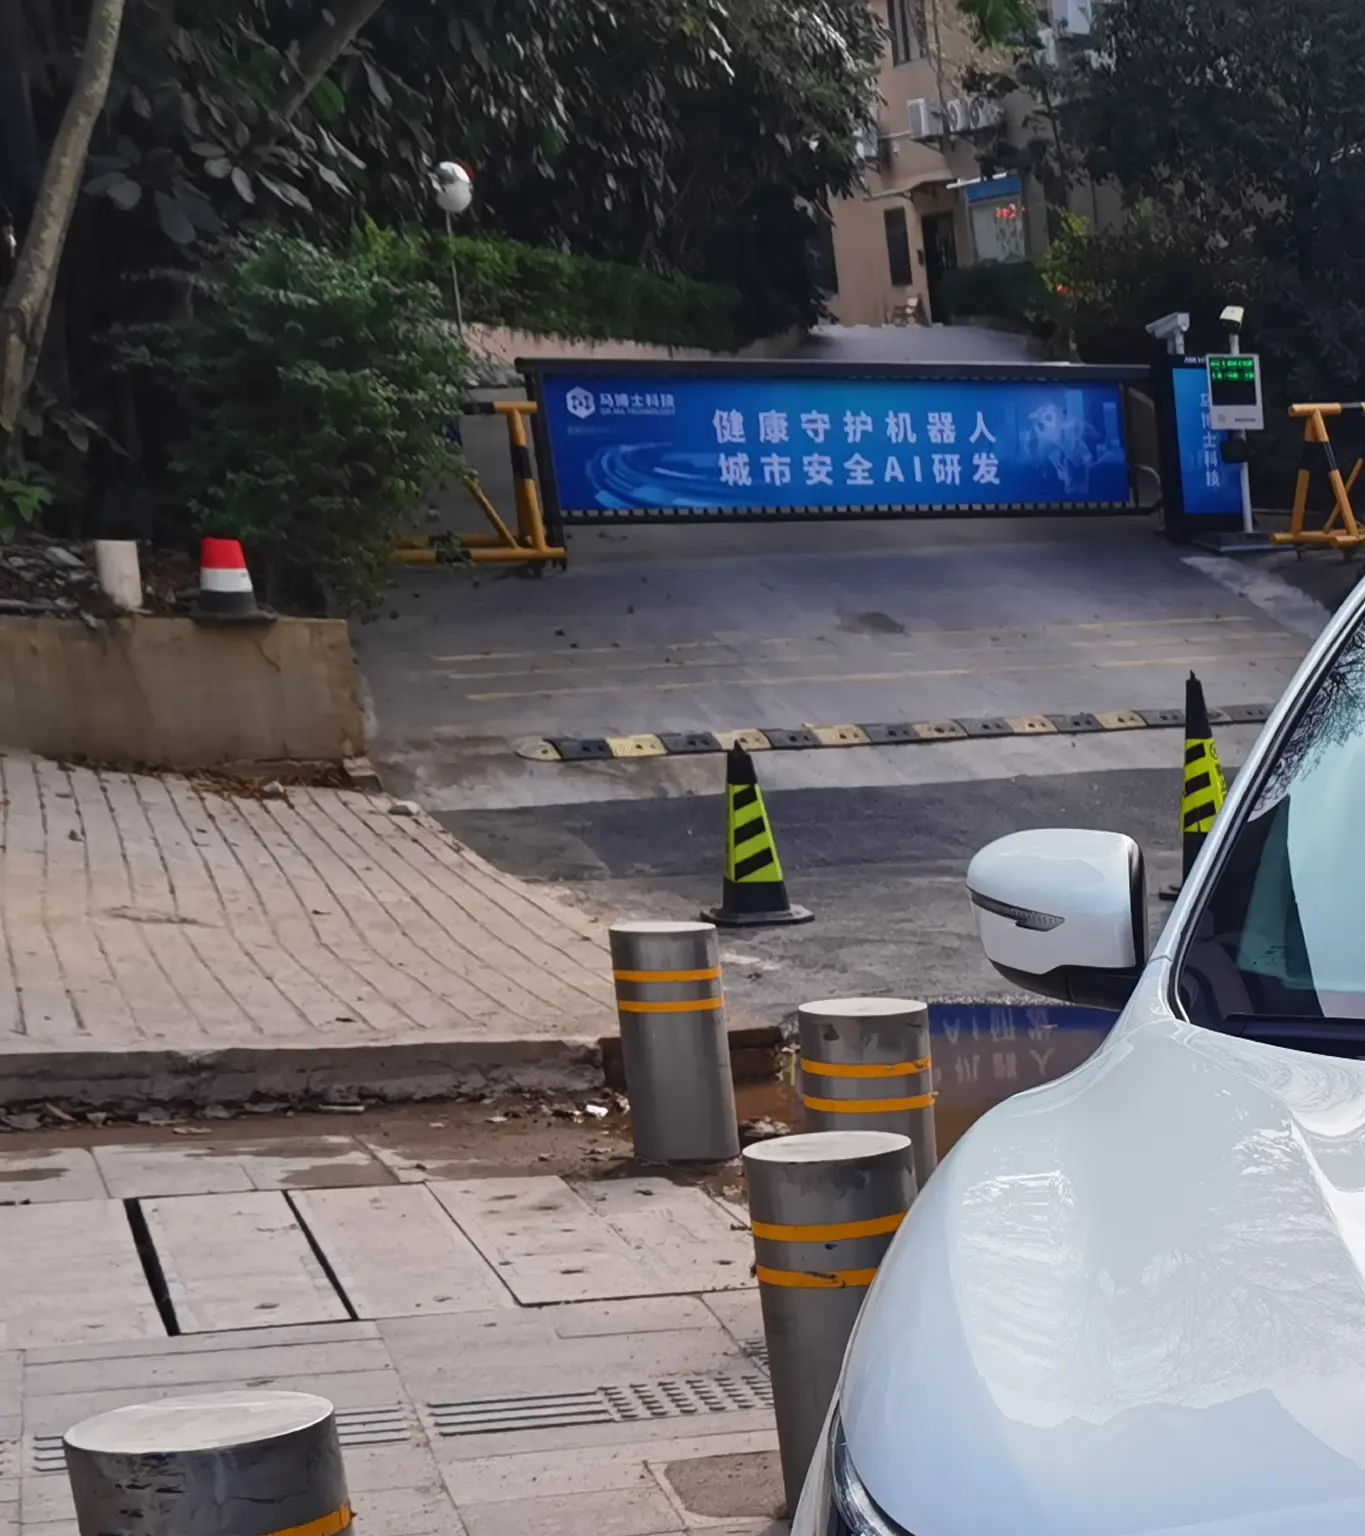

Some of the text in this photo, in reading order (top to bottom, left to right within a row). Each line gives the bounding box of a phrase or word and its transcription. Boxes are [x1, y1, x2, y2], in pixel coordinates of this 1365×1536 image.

[712, 408, 997, 444] 健康守护机器人
[718, 451, 1001, 487] 城市安全AI研发
